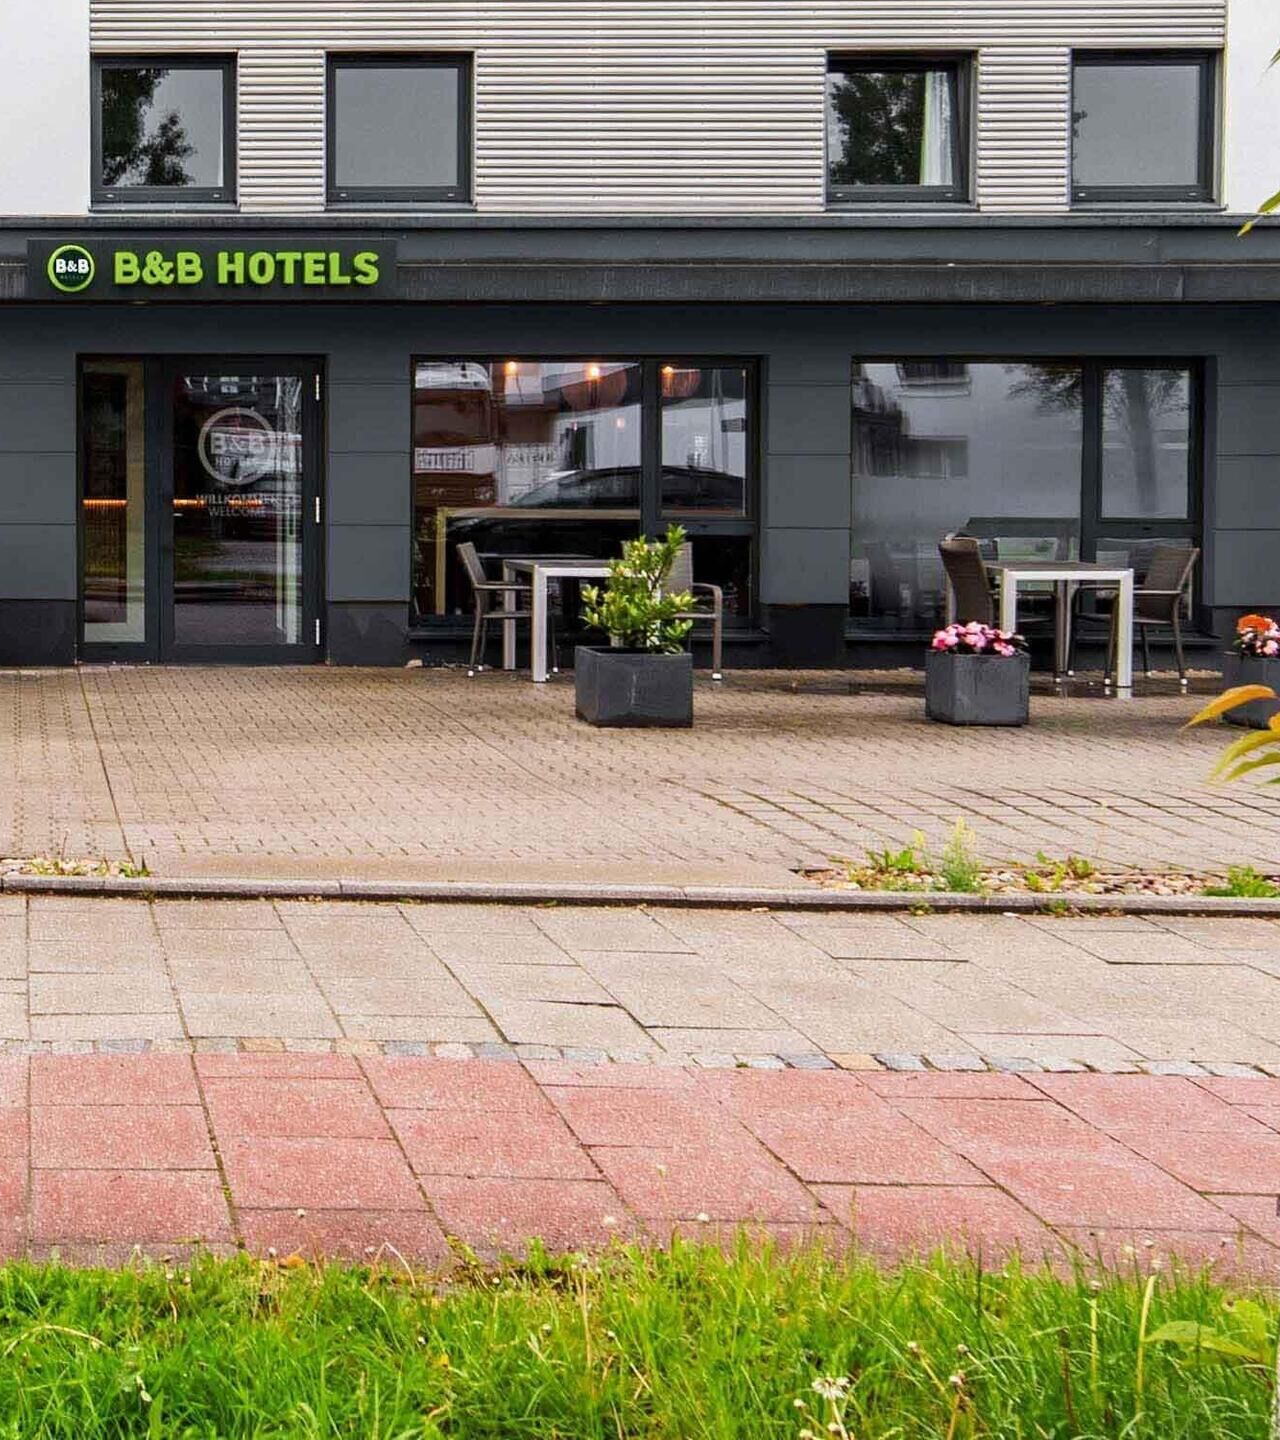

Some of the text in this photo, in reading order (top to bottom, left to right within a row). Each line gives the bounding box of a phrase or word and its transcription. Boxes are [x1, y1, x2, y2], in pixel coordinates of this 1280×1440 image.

[55, 258, 90, 274] B&B
[114, 251, 380, 285] B&B HOTELS
